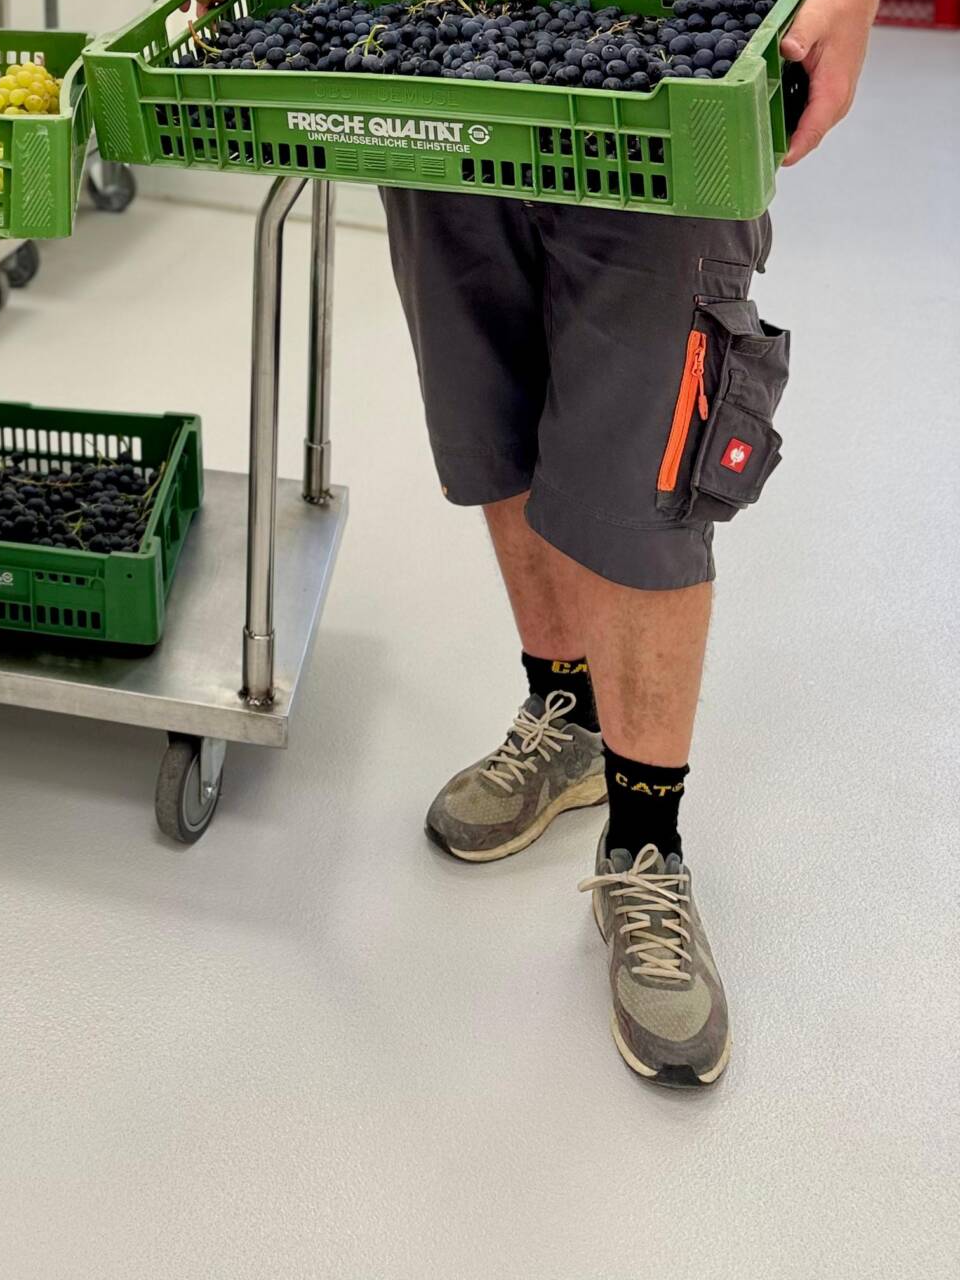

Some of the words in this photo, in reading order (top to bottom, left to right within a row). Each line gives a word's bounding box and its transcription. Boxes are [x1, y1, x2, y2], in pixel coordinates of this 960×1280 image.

[287, 112, 364, 135] FRISCHE
[368, 117, 464, 142] QUALITÄT
[411, 140, 471, 153] LEIHSTEIGE
